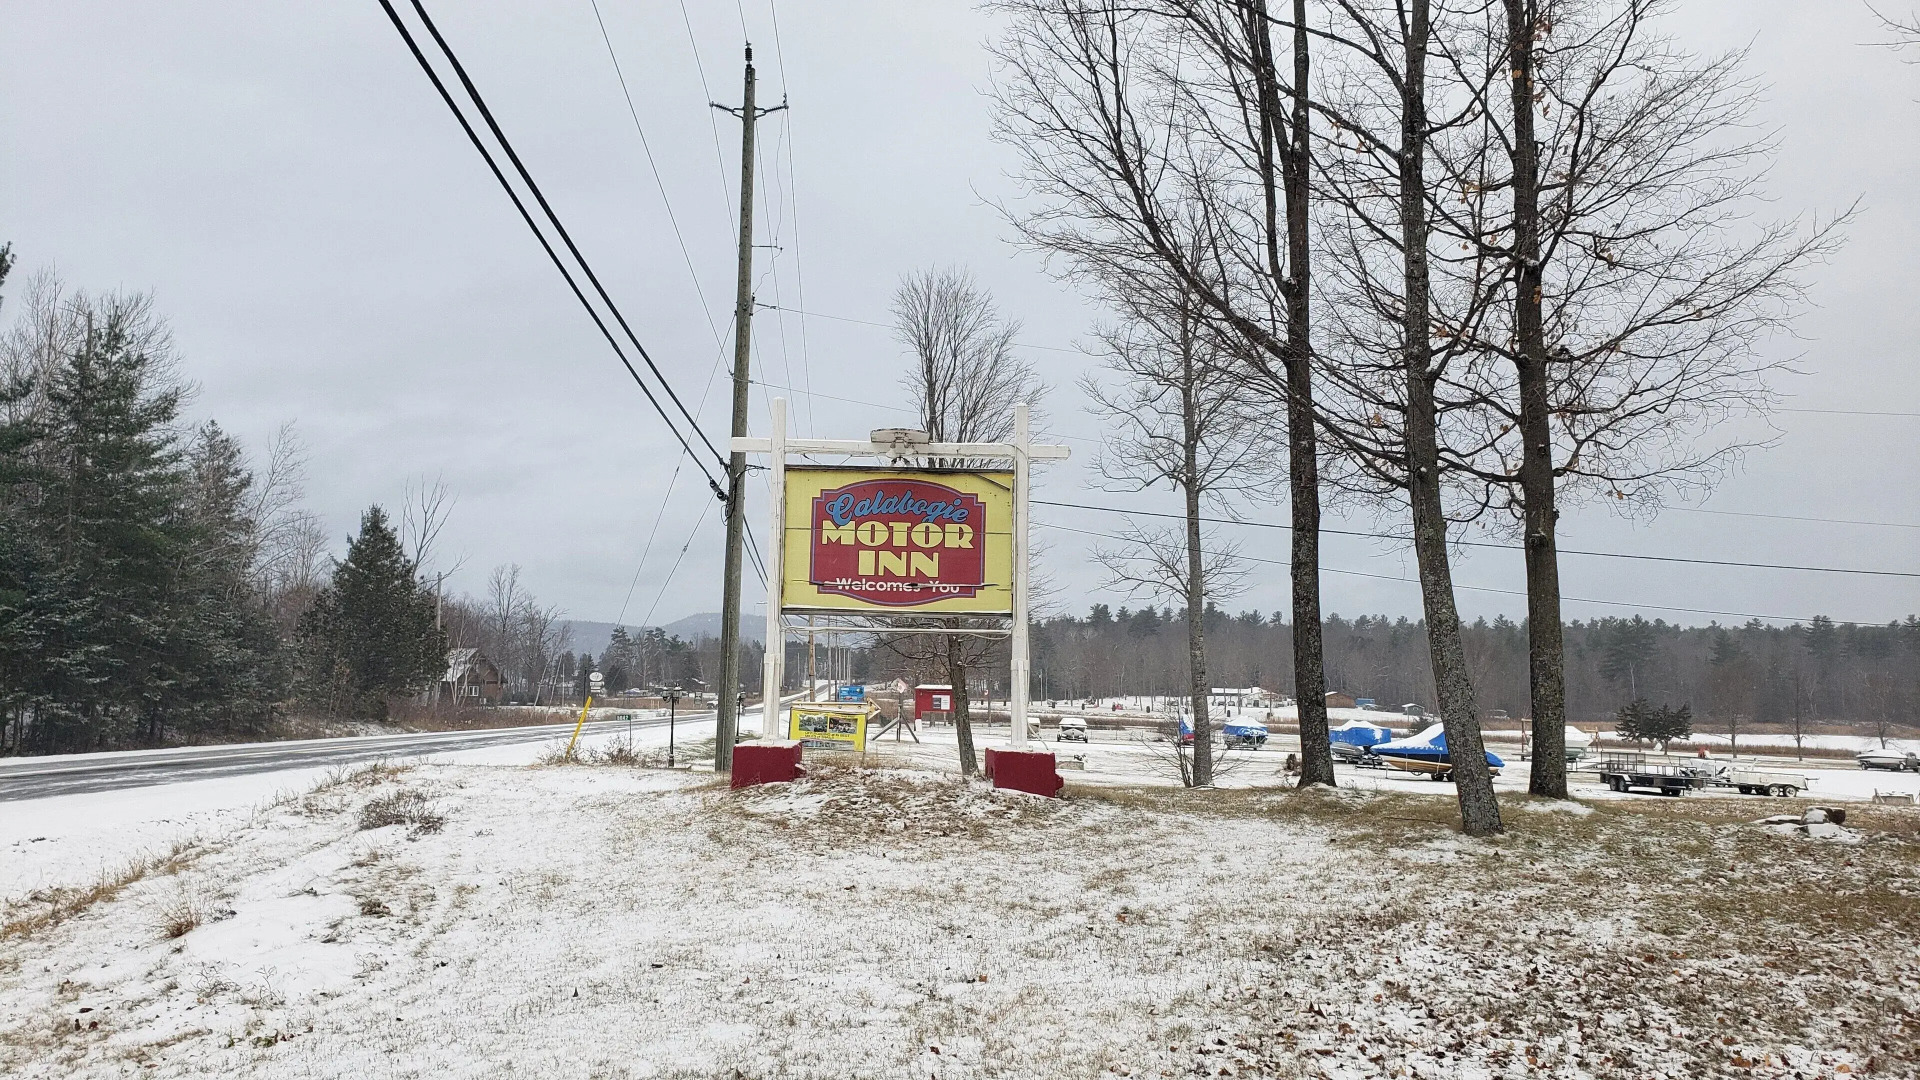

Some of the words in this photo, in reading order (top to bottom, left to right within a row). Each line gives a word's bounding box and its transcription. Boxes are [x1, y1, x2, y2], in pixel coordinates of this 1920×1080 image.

[825, 490, 969, 526] Calabogie
[821, 520, 974, 549] MOTOR
[858, 550, 939, 578] INN
[929, 580, 960, 594] You
